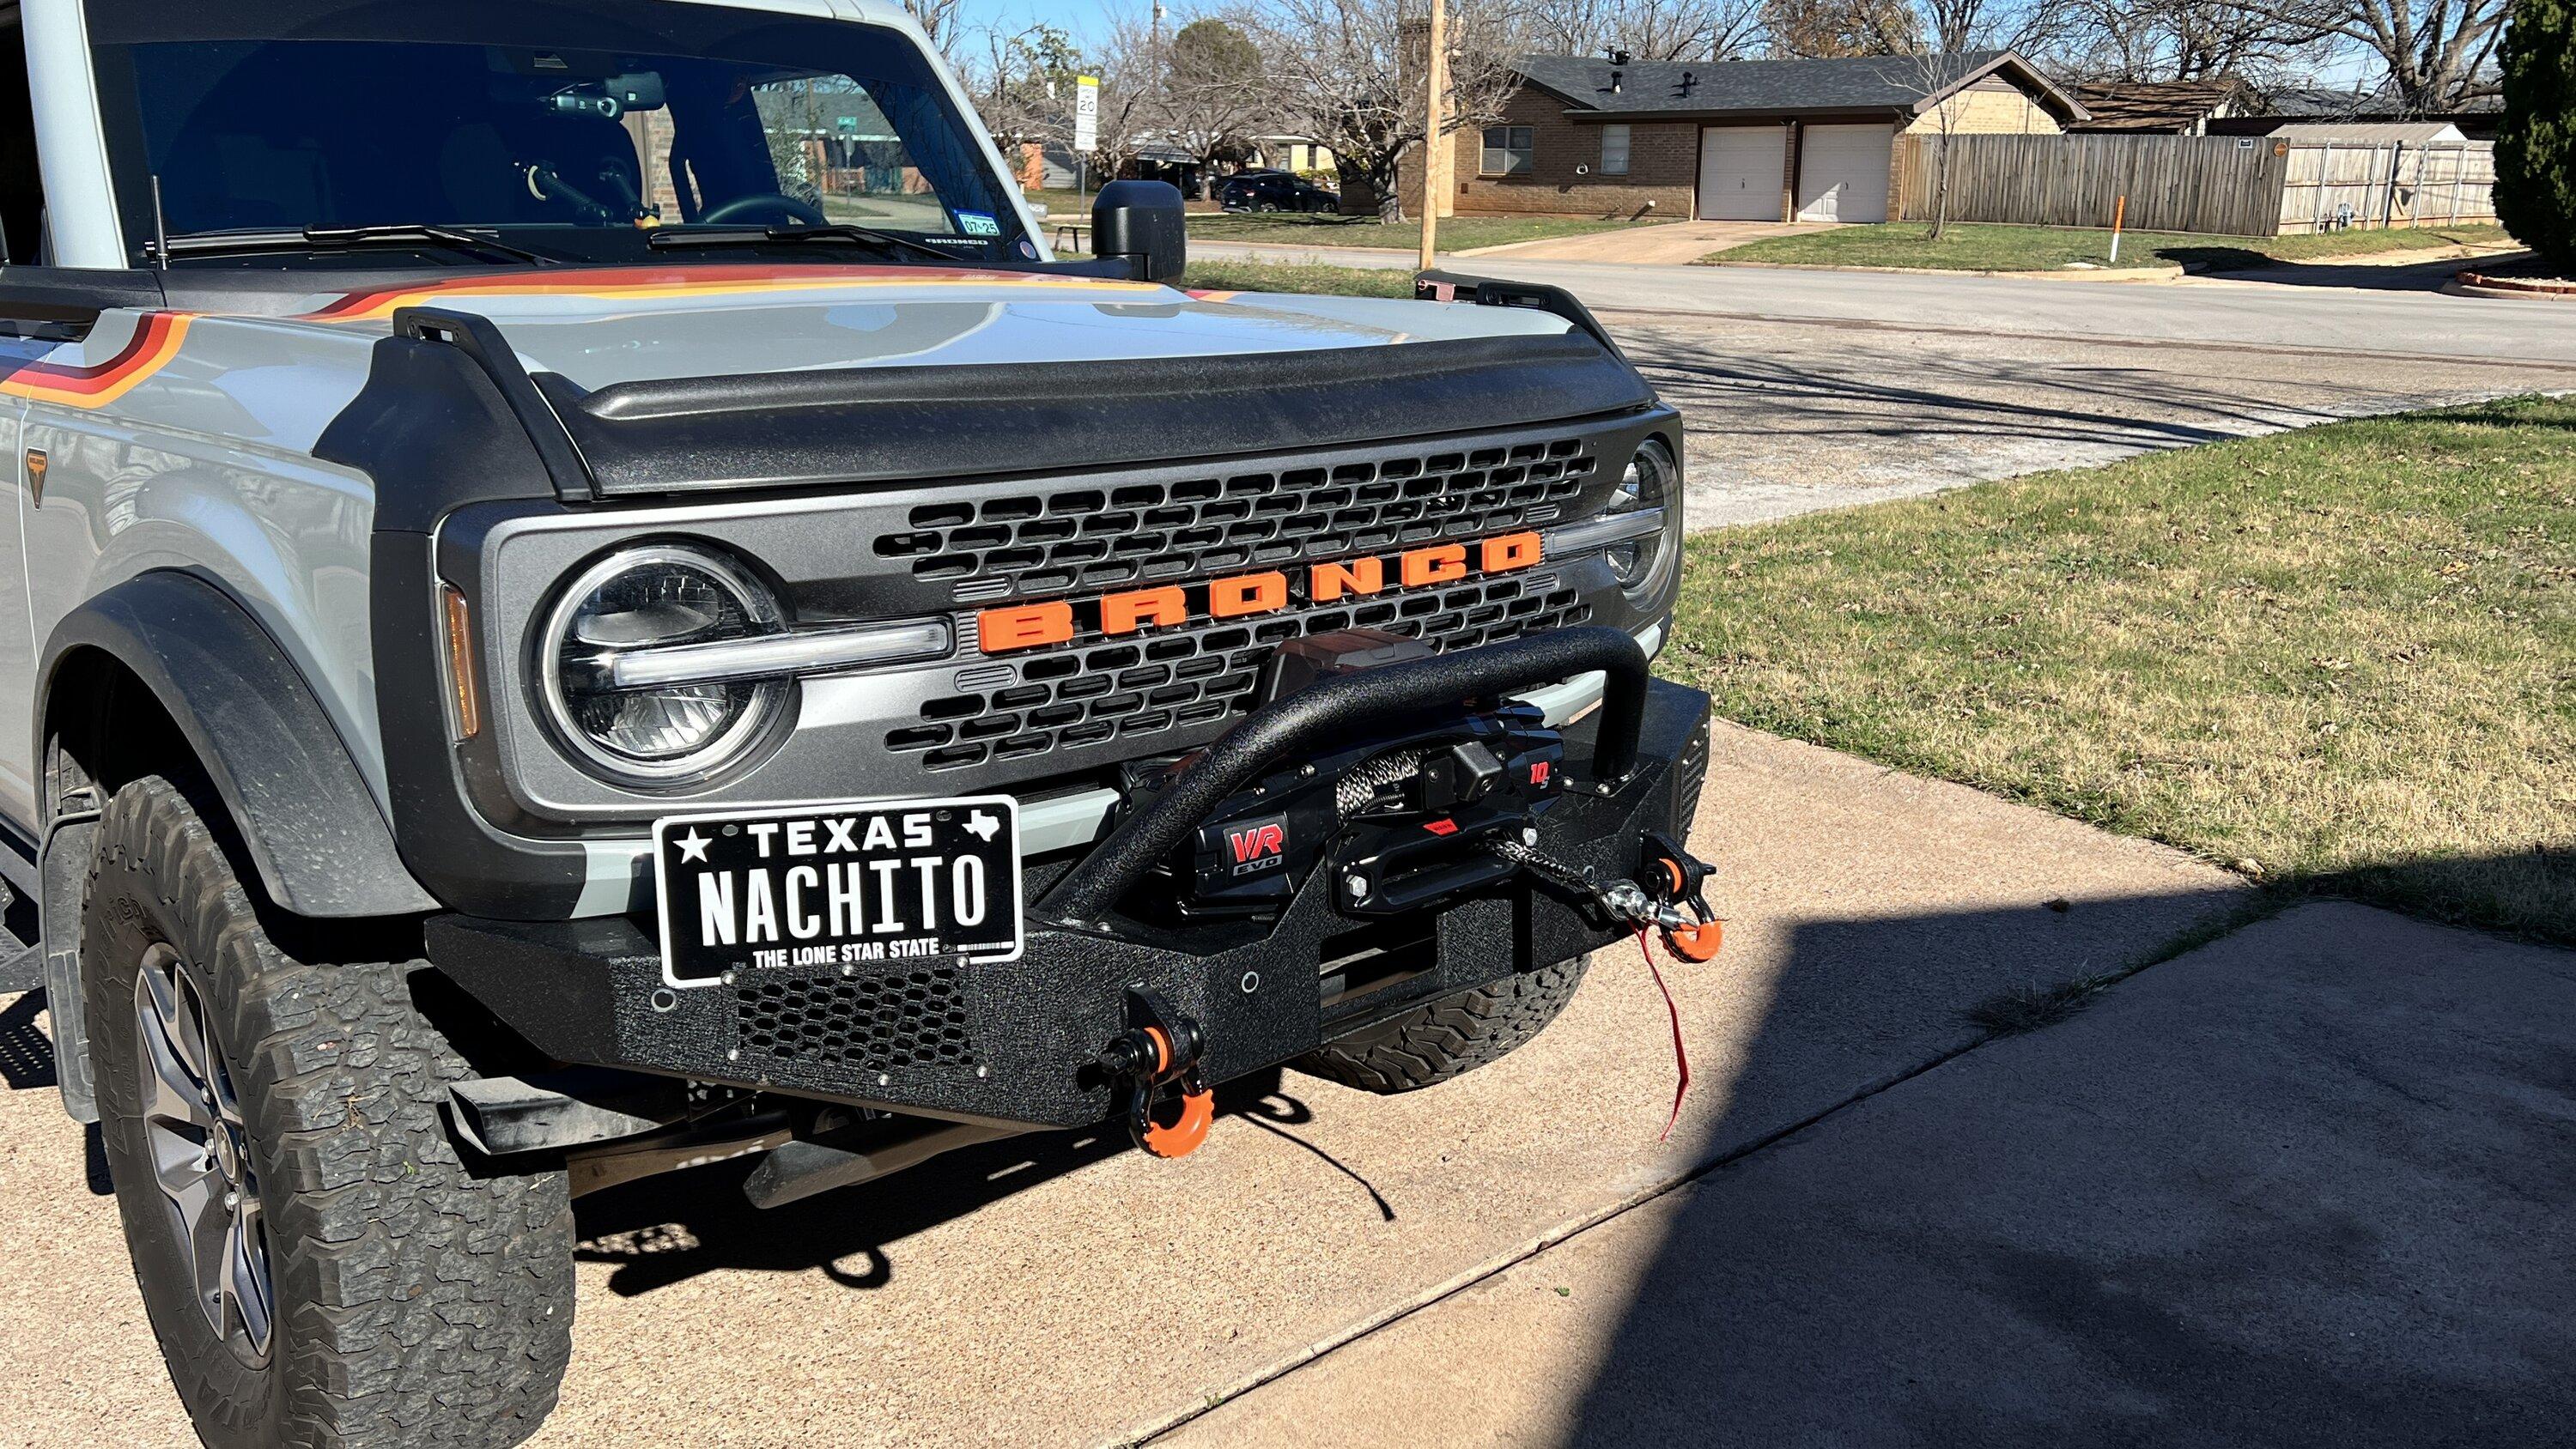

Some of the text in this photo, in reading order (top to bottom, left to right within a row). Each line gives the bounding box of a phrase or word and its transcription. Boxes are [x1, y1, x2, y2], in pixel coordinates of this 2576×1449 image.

[1079, 100, 1095, 112] 20
[964, 221, 998, 235] 07 25
[977, 531, 1542, 653] BRONCO
[747, 812, 933, 858] TEXAS
[1230, 823, 1284, 864] VR
[1236, 858, 1279, 874] EVO
[697, 853, 986, 947] NACHITO
[752, 937, 940, 968] THE LONE STAR STATE
